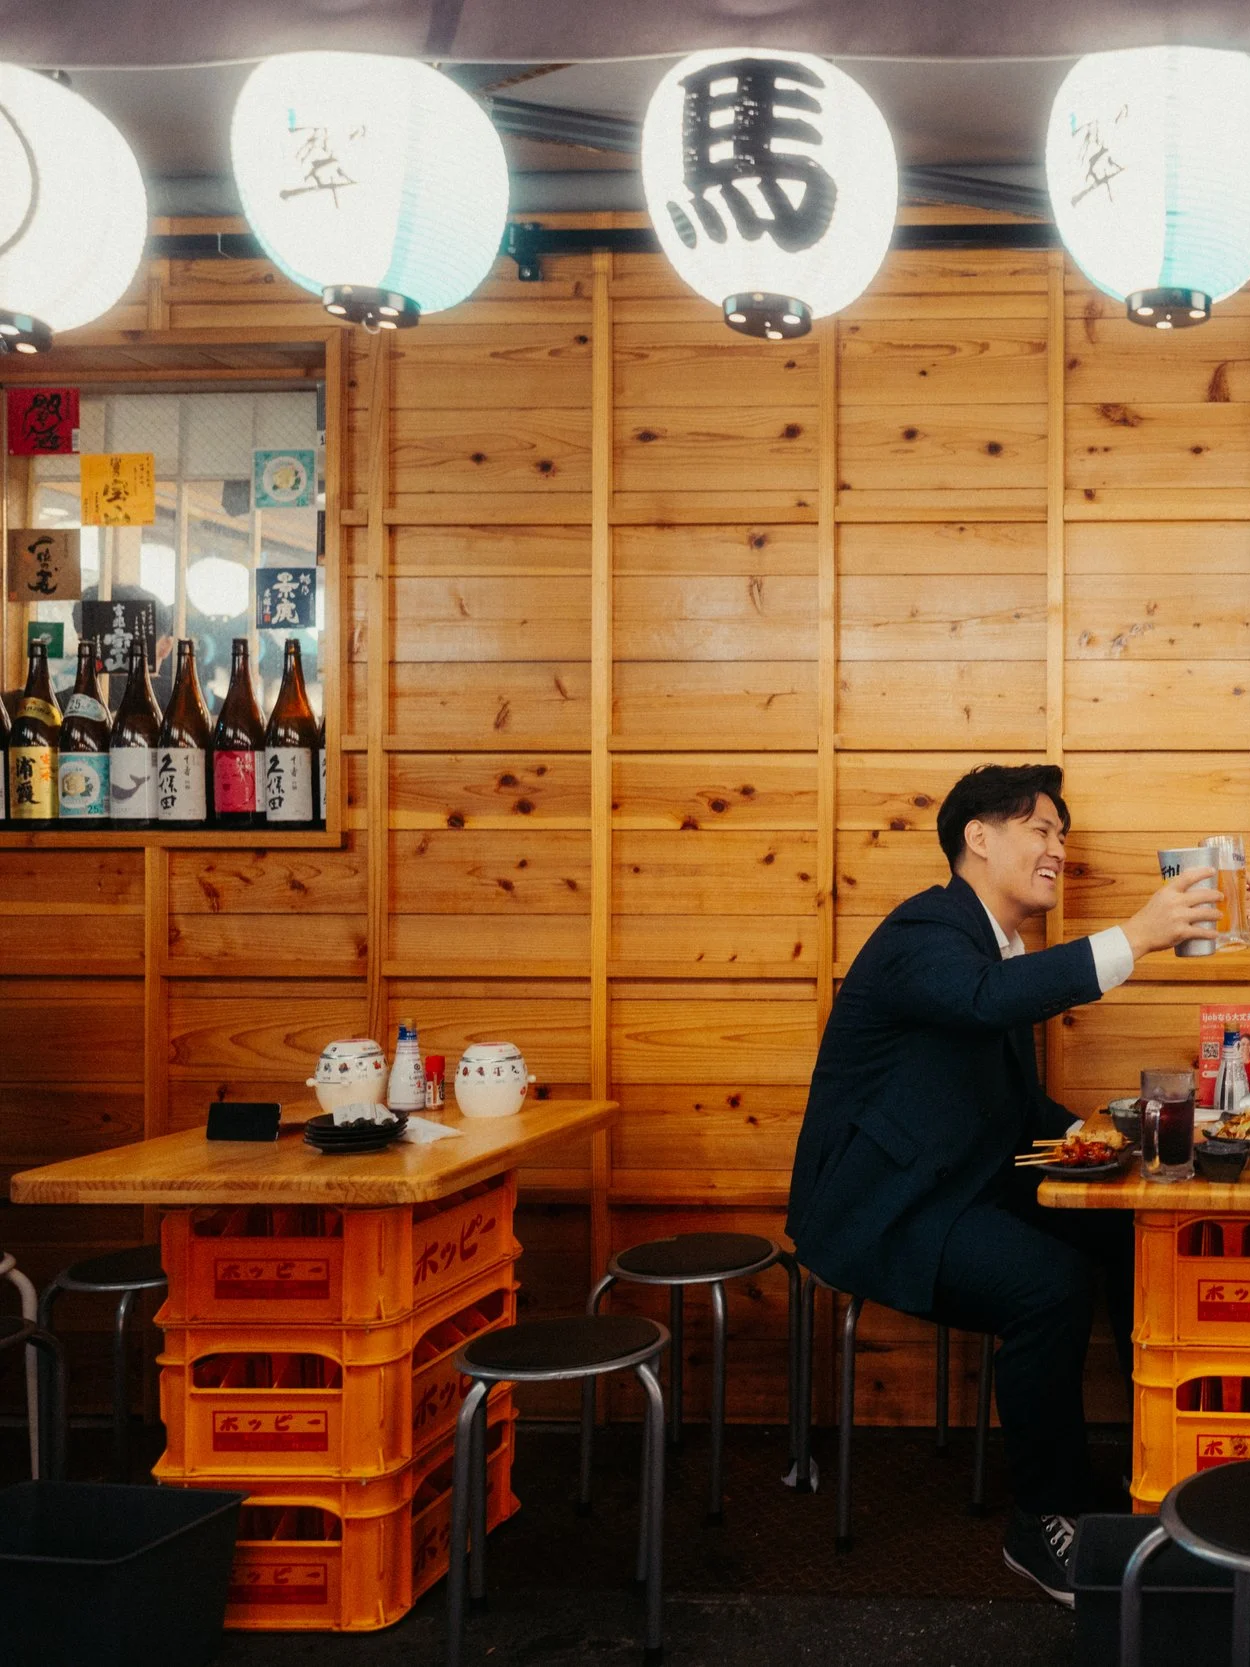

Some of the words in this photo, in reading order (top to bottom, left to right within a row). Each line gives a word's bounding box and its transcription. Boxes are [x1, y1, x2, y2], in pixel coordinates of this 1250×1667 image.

[666, 58, 838, 252] 馬
[159, 753, 178, 810] 久保田
[267, 754, 285, 811] 久保田
[221, 1262, 323, 1281] ホッピー
[414, 1213, 497, 1286] ホッピー
[220, 1414, 322, 1432] ホッピー
